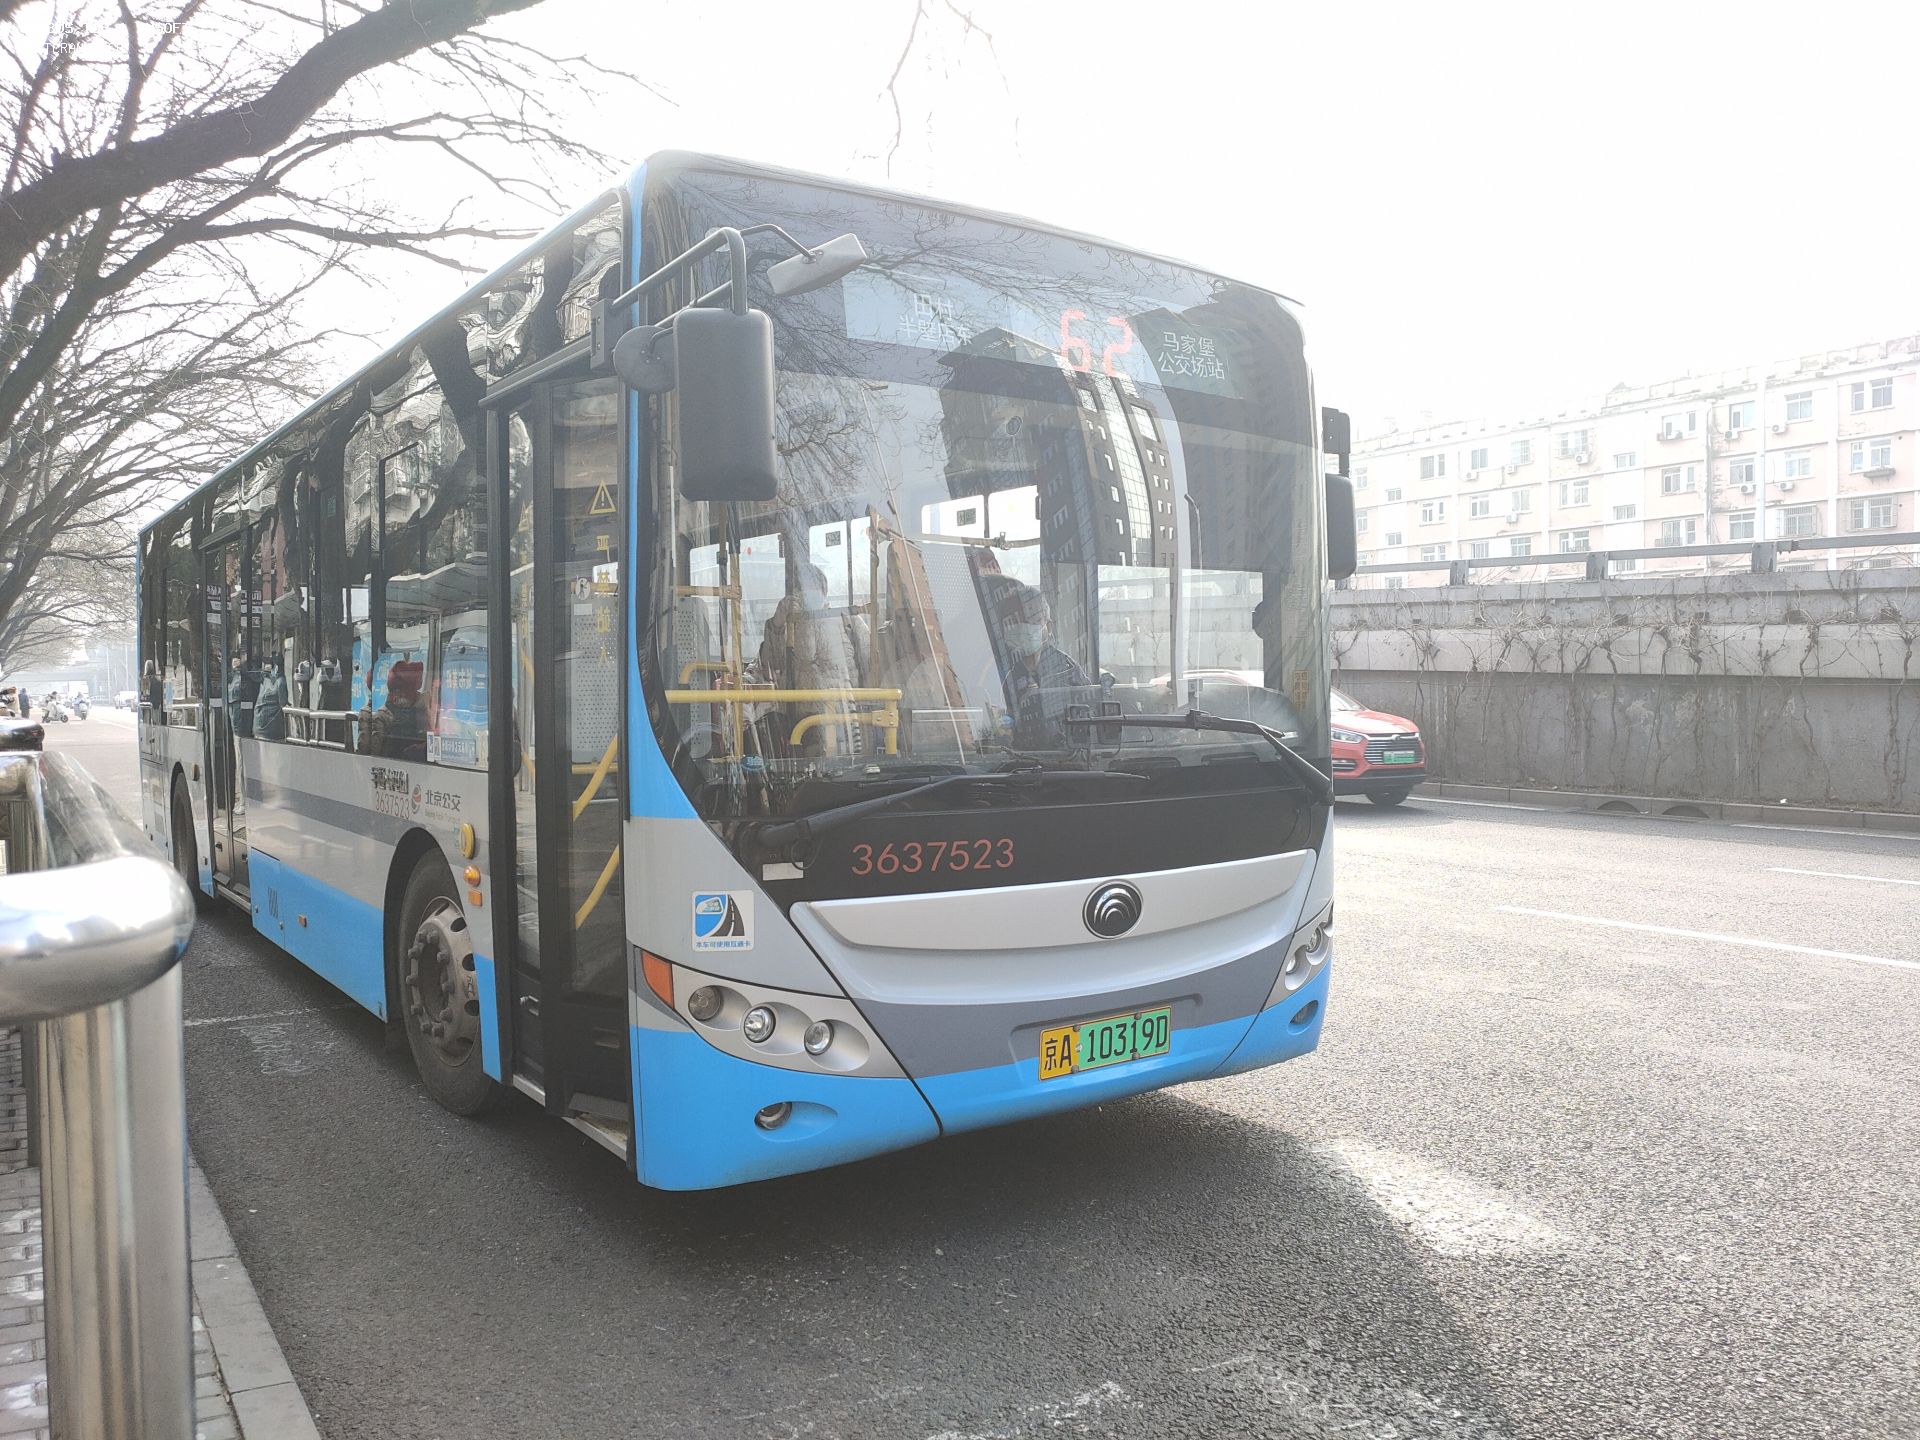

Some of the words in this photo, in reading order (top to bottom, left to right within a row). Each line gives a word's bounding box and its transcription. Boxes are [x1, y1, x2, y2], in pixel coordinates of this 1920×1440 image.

[913, 293, 954, 320] 田村
[1060, 308, 1132, 380] 62
[1162, 331, 1216, 357] 马家堡
[1158, 351, 1225, 380] 公交场站
[375, 790, 410, 820] 3637523
[424, 789, 462, 812] 北京公交
[851, 837, 1015, 875] 3637523
